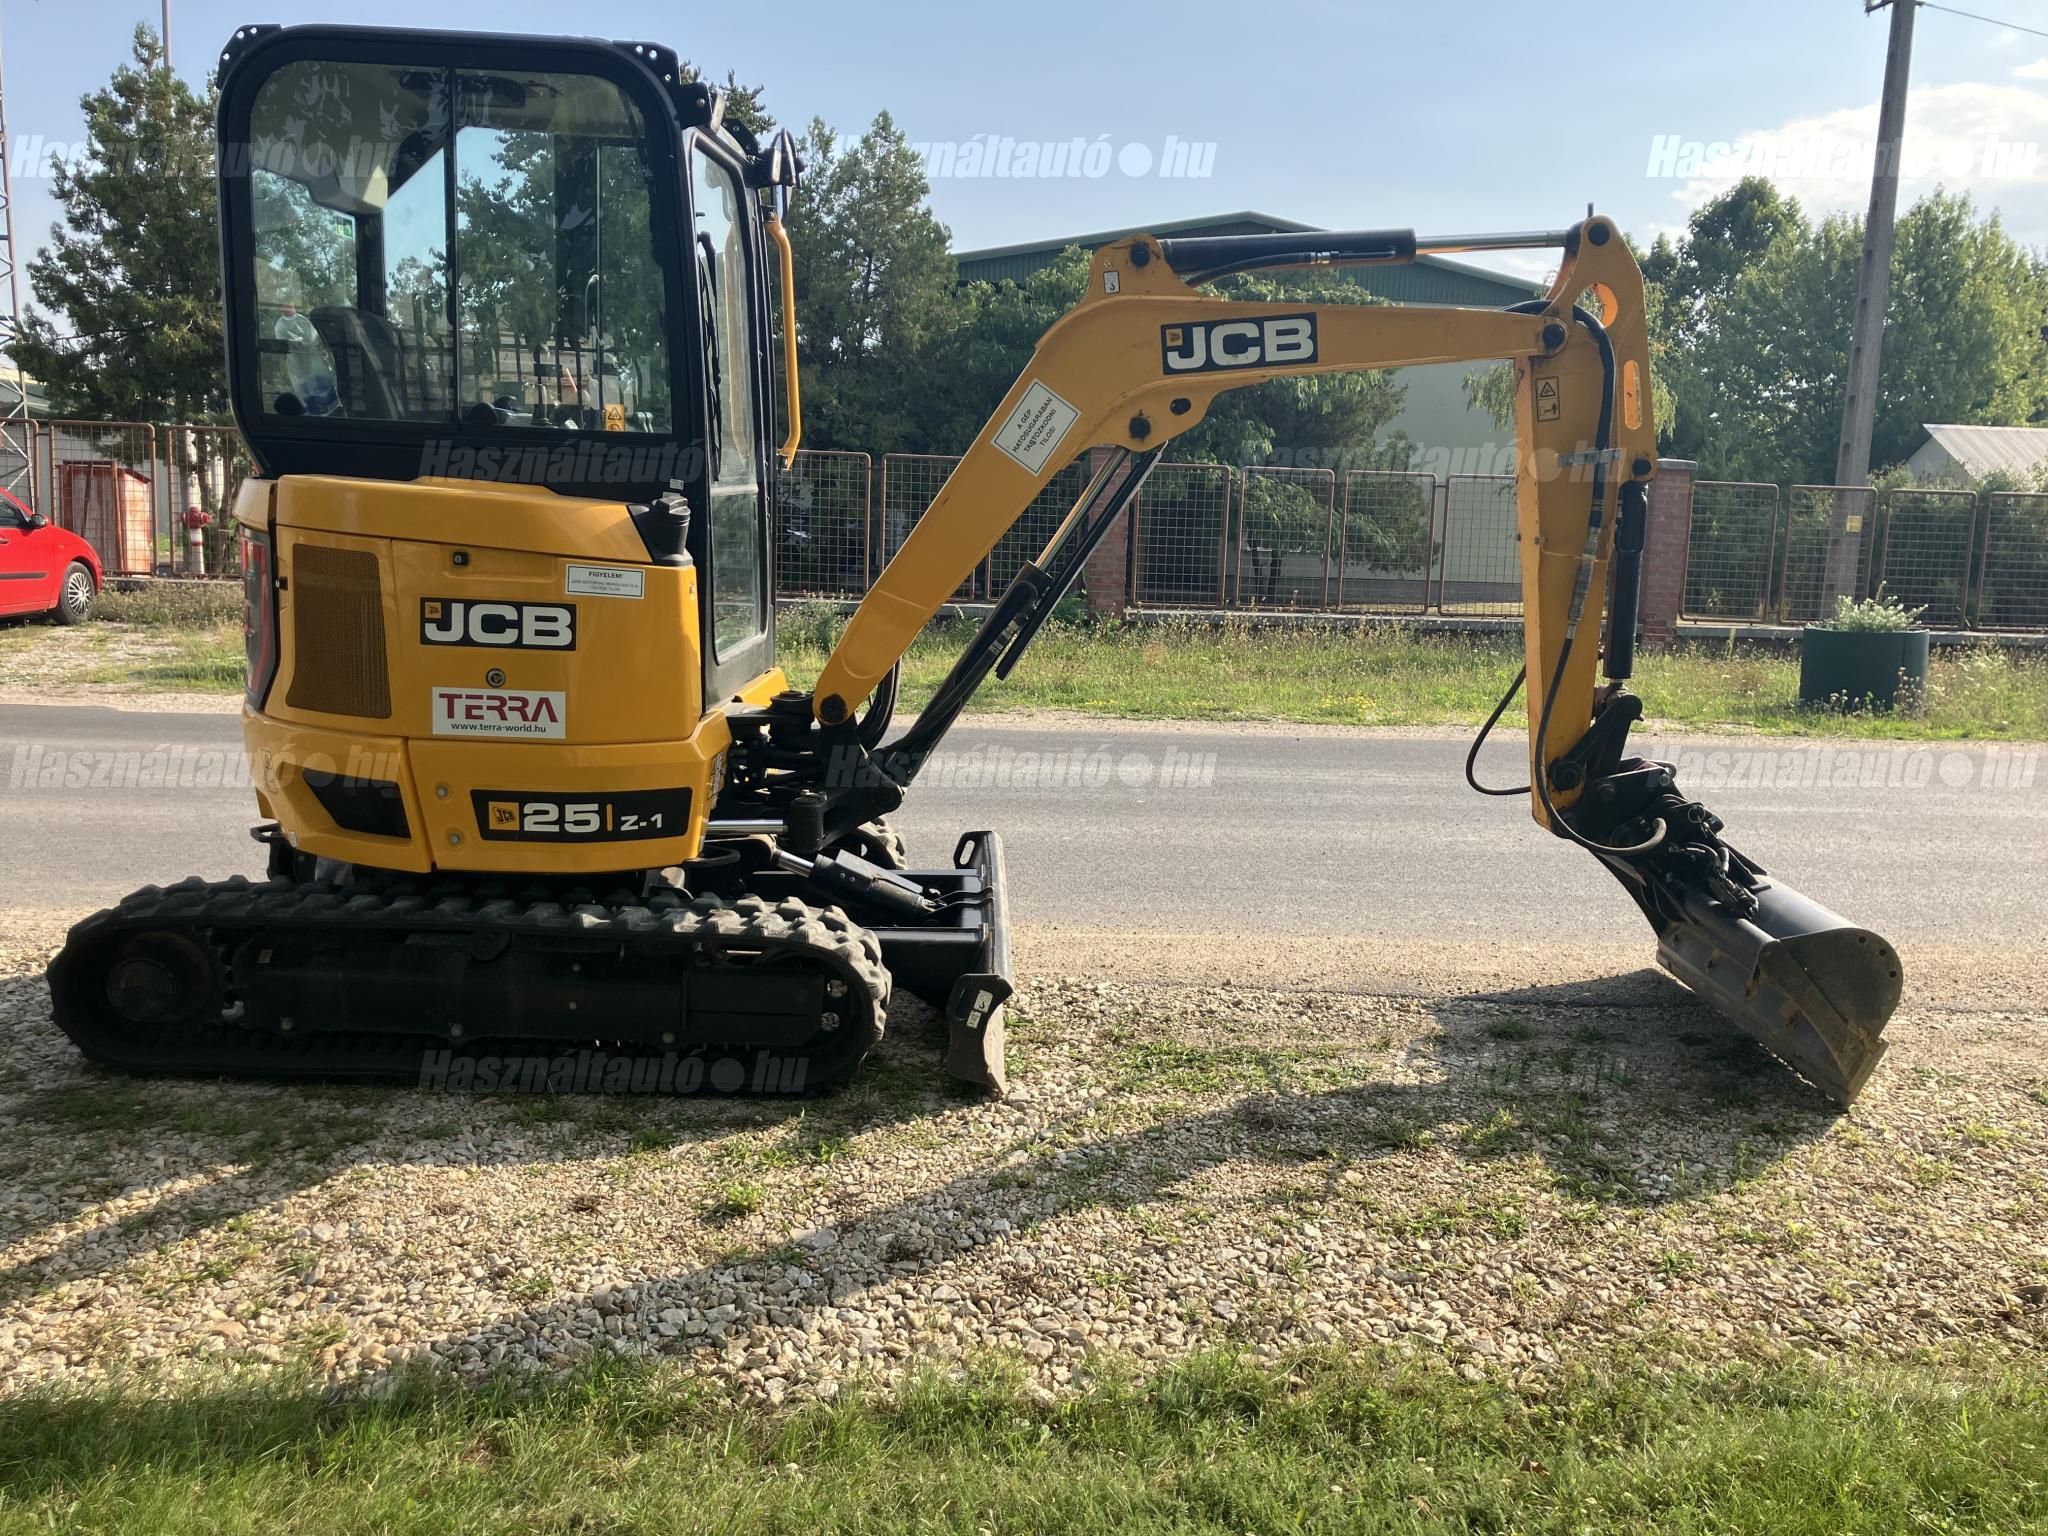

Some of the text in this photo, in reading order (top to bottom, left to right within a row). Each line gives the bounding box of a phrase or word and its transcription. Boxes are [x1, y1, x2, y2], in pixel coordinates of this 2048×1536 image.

[1167, 318, 1314, 370] JCB
[424, 602, 573, 647] JCB
[438, 693, 559, 723] TERRA
[450, 722, 547, 733] www.terra-world.hu
[523, 802, 601, 833] 25
